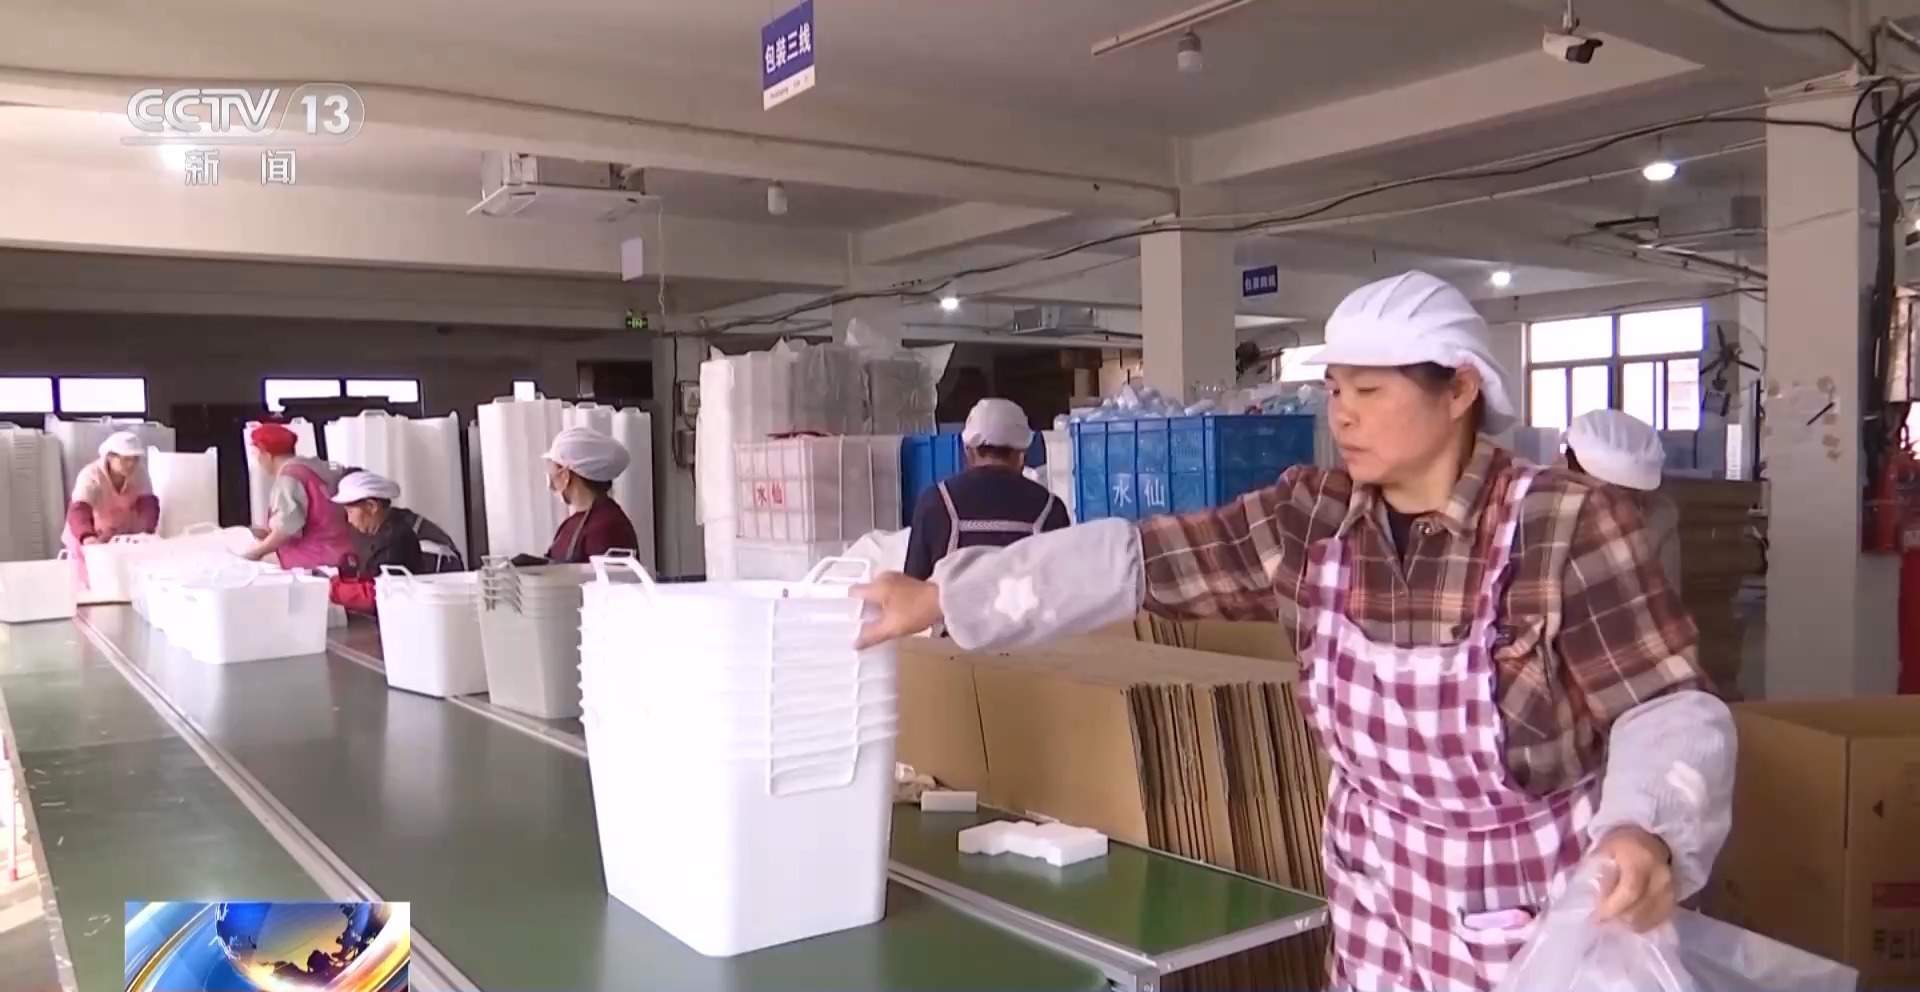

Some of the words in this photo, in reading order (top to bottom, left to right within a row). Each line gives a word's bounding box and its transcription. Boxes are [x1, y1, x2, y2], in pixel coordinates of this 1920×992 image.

[765, 22, 811, 74] 包装三线
[756, 482, 783, 507] 水仙
[1112, 477, 1165, 507] 水仙
